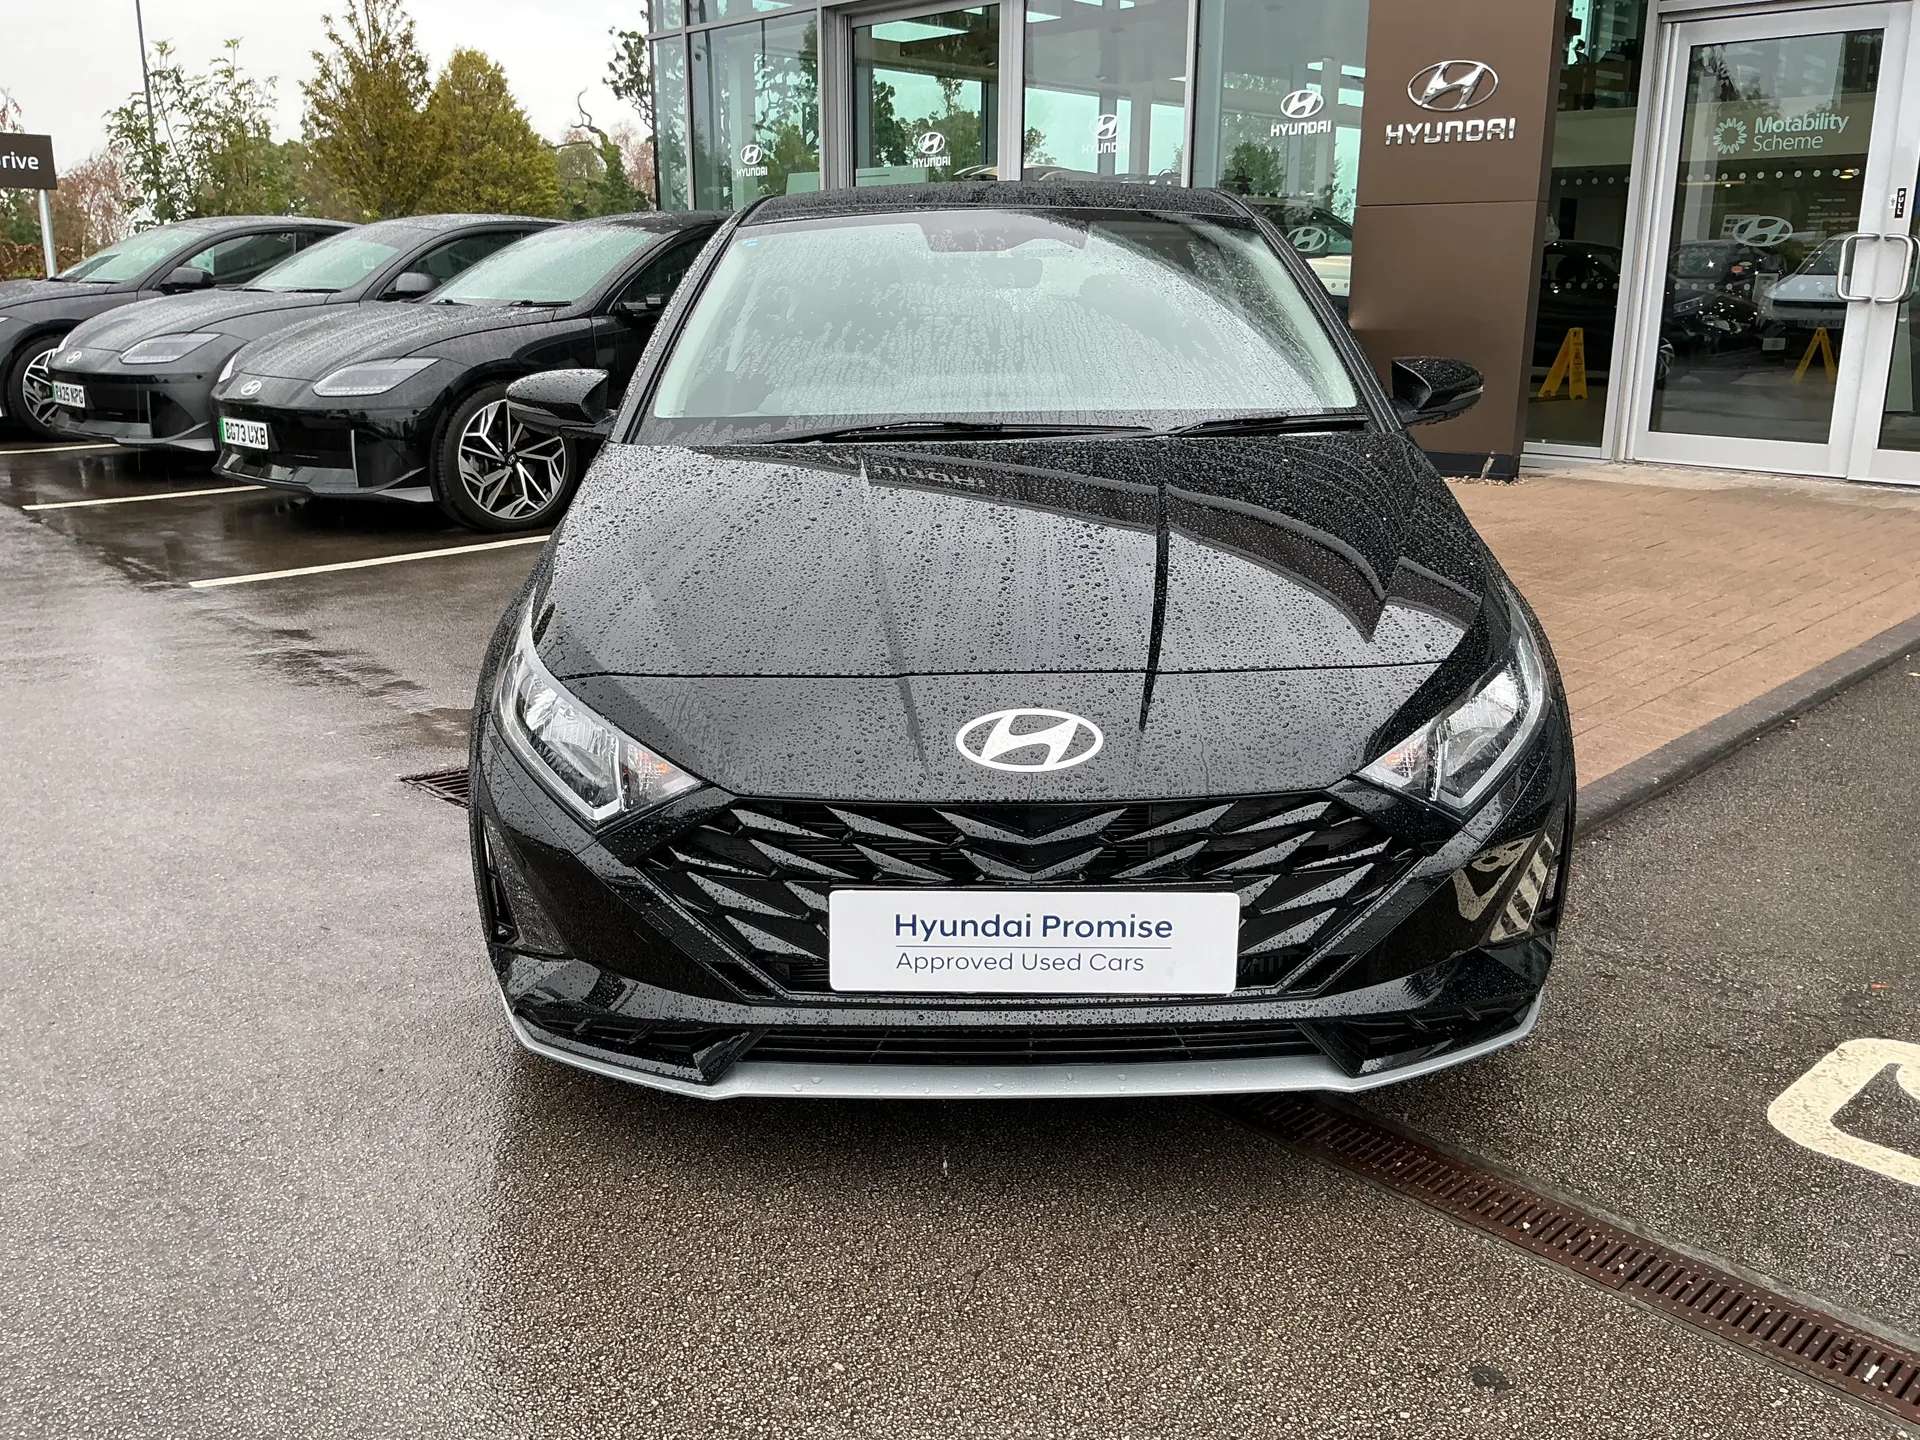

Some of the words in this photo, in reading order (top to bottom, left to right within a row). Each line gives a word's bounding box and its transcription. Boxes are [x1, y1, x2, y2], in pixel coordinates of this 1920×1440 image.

[1270, 119, 1332, 137] HYUNDAI
[1385, 117, 1517, 146] HYUNDAI
[1754, 112, 1850, 134] Motability
[1081, 142, 1130, 154] HYUND
[1751, 134, 1824, 152] Scheme
[0, 151, 40, 170] rive
[911, 154, 951, 169] HYUNDAI
[736, 166, 768, 178] HYUNDAI
[1896, 190, 1905, 215] PULL
[225, 421, 247, 442] BG73
[247, 425, 266, 446] UXB
[895, 913, 1032, 942] Hyundai
[1042, 913, 1173, 938] Promise
[896, 952, 1014, 974] Approved
[1022, 952, 1081, 972] Used
[1089, 953, 1145, 972] Cars
